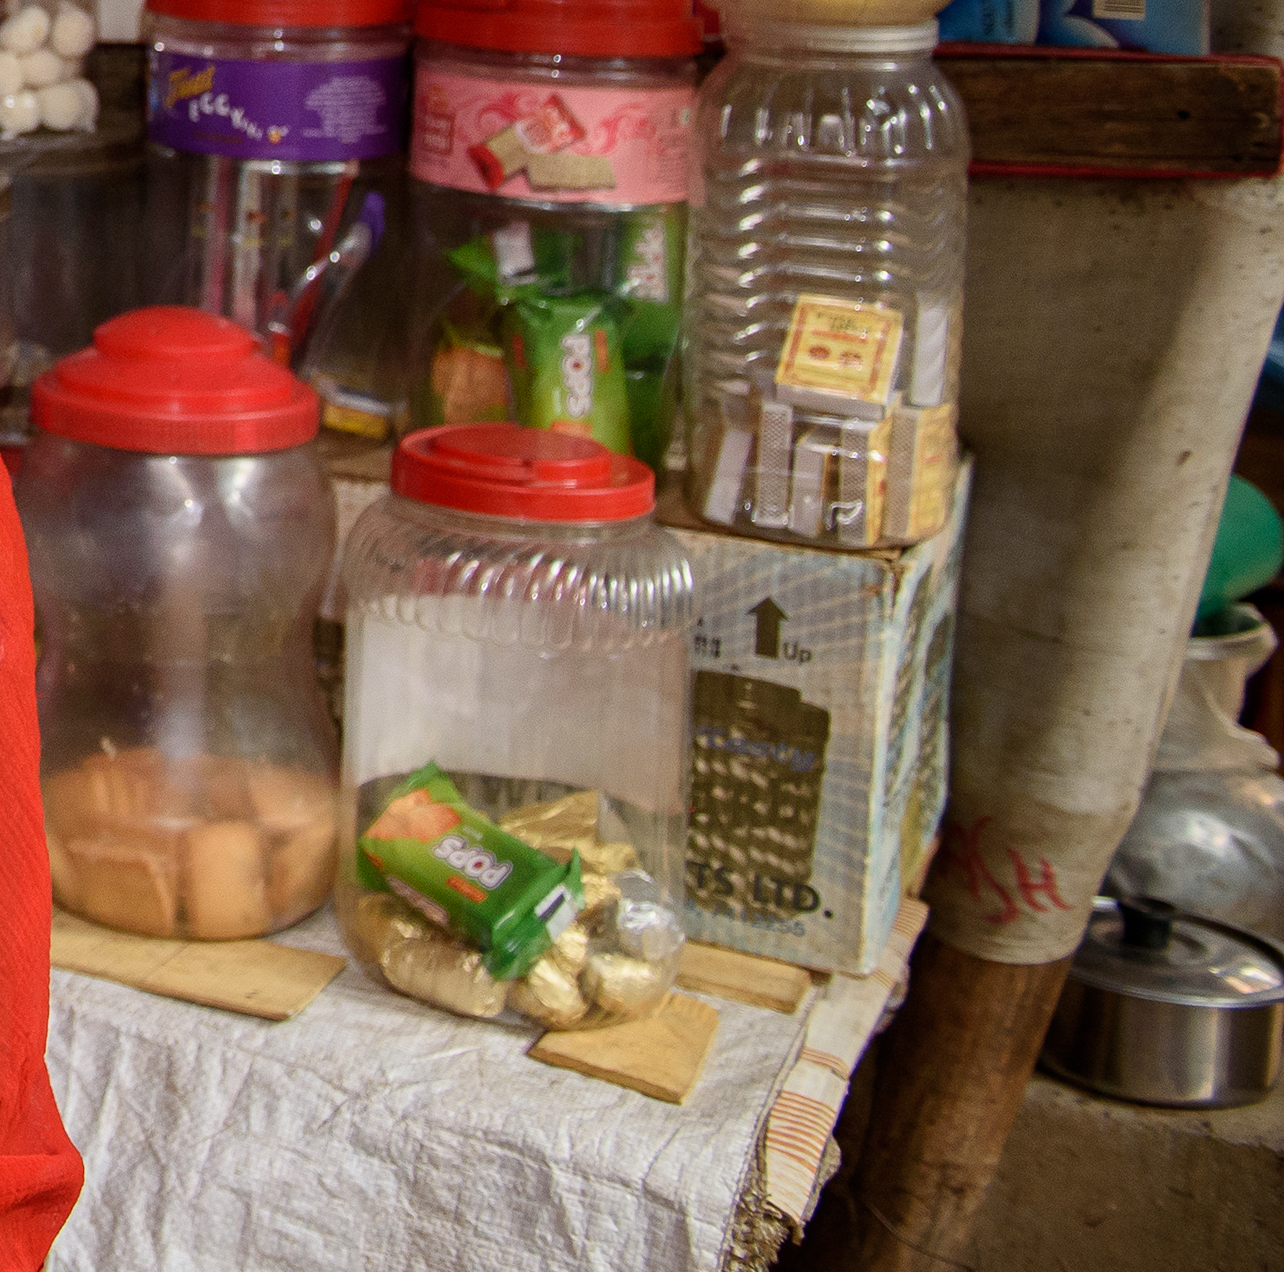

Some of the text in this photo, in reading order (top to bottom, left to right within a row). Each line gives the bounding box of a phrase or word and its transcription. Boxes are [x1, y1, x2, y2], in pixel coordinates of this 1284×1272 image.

[562, 334, 593, 418] POPS
[783, 641, 813, 665] Up
[434, 835, 513, 890] POPS
[684, 860, 735, 898] TS
